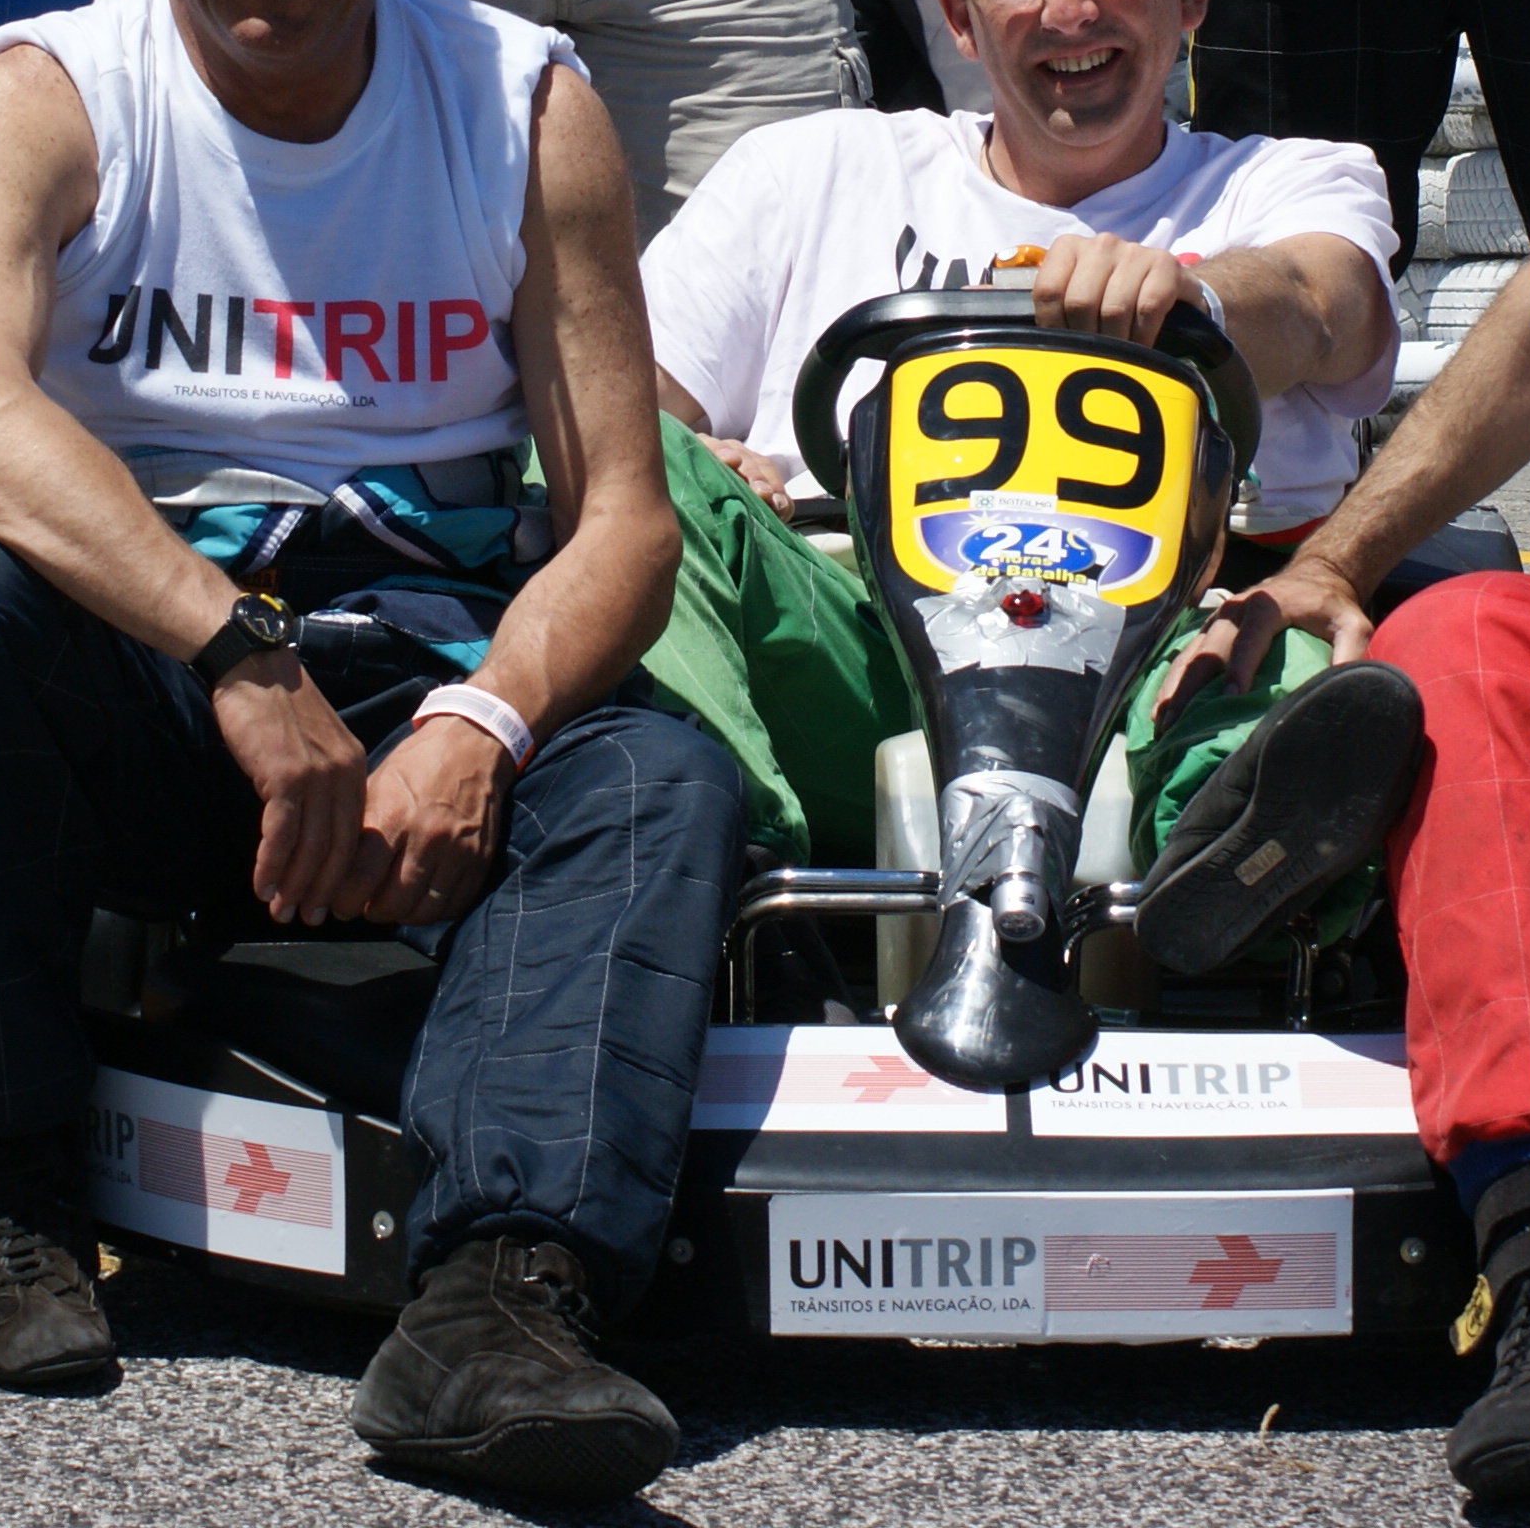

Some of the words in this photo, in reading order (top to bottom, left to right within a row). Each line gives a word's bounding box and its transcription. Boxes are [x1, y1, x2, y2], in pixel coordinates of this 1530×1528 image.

[87, 284, 490, 383] UNITRIP
[173, 383, 249, 400] TRÂNSITOS
[252, 389, 261, 400] E
[264, 389, 350, 408] NAVEGAÇÃO,
[352, 395, 379, 408] LDA.
[914, 360, 1166, 510] 99
[998, 497, 1053, 510] BATALHA
[979, 524, 1068, 563] 24
[999, 553, 1054, 566] horas
[974, 565, 1000, 578] da
[1006, 564, 1088, 585] Batalha
[1048, 1061, 1291, 1095] UNITRIP
[1051, 1098, 1132, 1110] TRÂNSITOS
[1138, 1101, 1145, 1110] E
[1152, 1098, 1255, 1112] NAVEGAÇÃO,
[1260, 1100, 1291, 1109] LDA.
[789, 1236, 1037, 1289] UNITRIP
[790, 1297, 873, 1313] TRÂNSITOS
[878, 1299, 886, 1312] E
[892, 1295, 997, 1315] NAVEGAÇÃO,
[1002, 1298, 1036, 1311] LDA.
